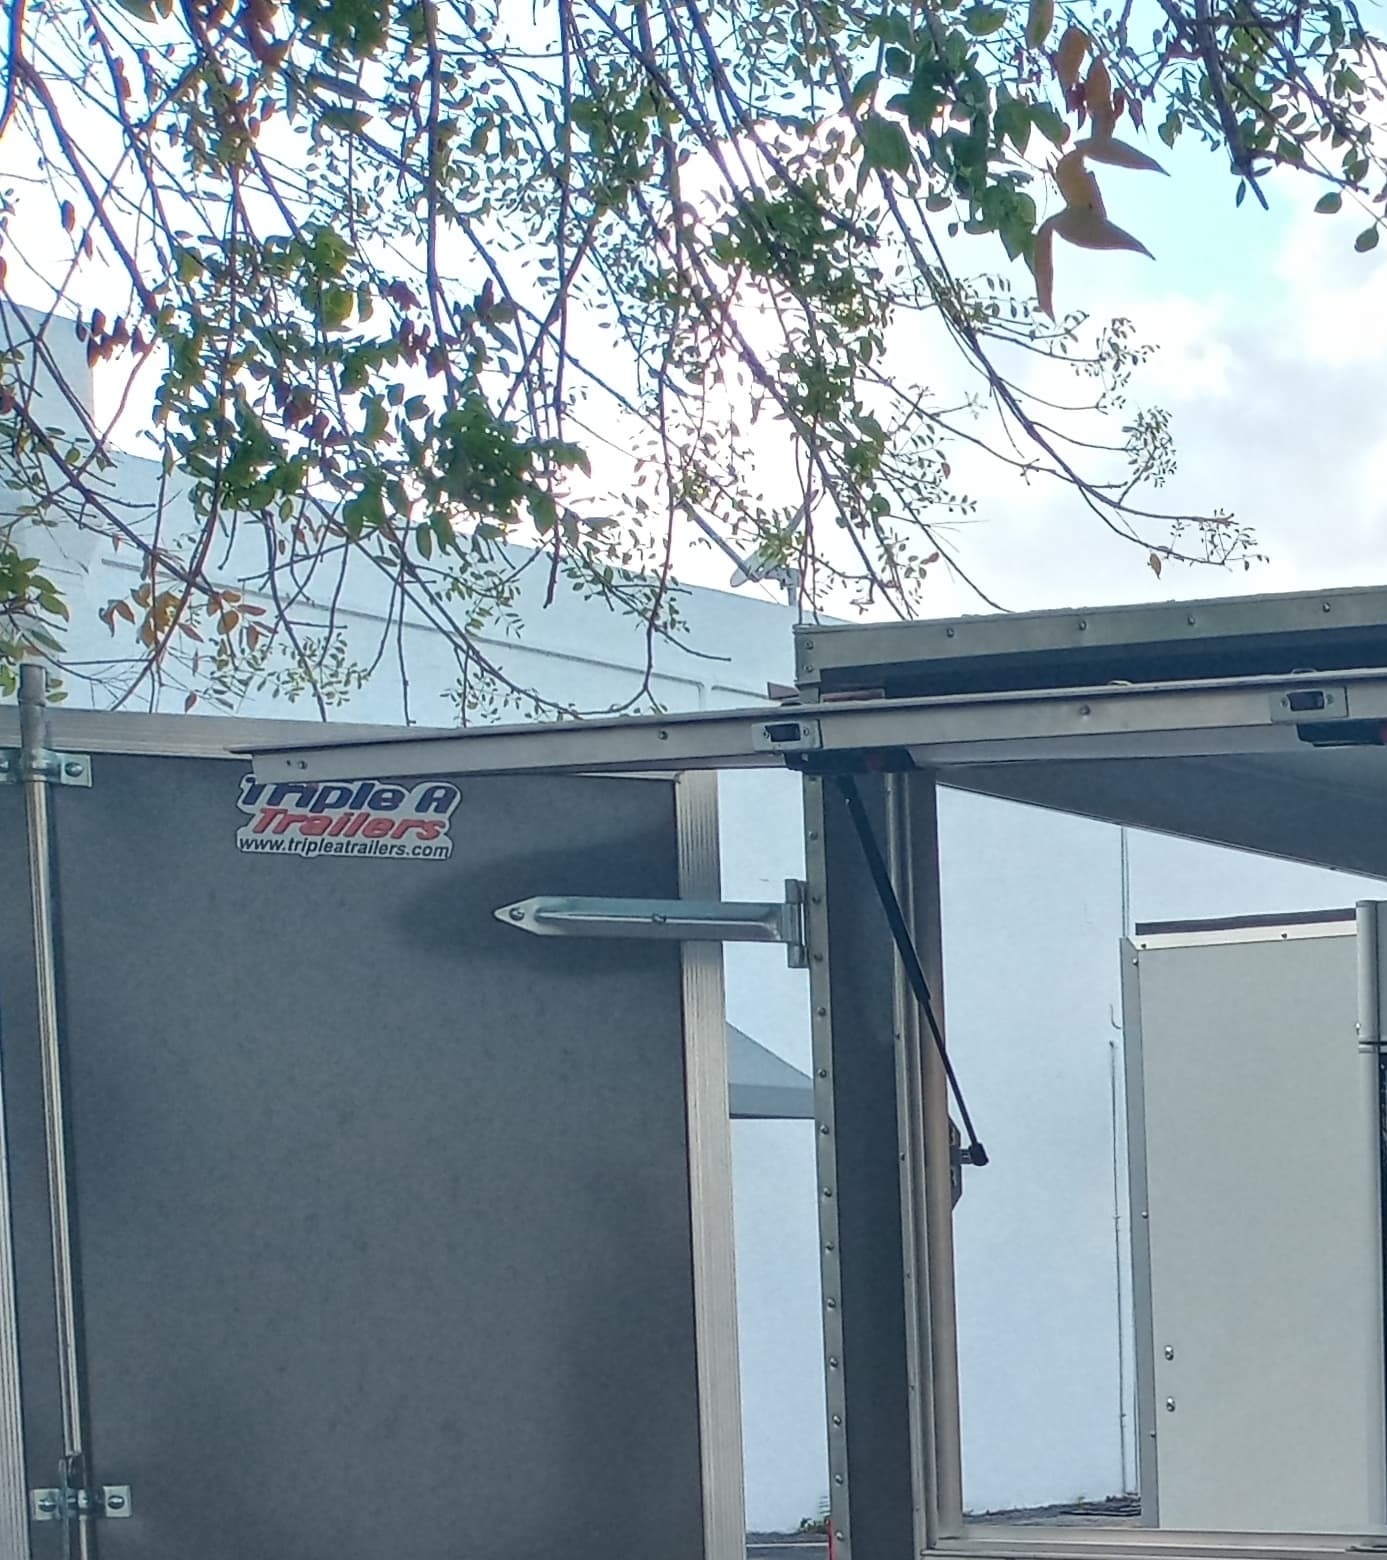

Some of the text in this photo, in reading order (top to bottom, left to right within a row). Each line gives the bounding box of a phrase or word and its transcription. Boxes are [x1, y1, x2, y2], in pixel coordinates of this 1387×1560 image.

[414, 785, 457, 814] A
[252, 807, 447, 841] Trailers
[239, 836, 449, 858] www.tripleatrailers.com
